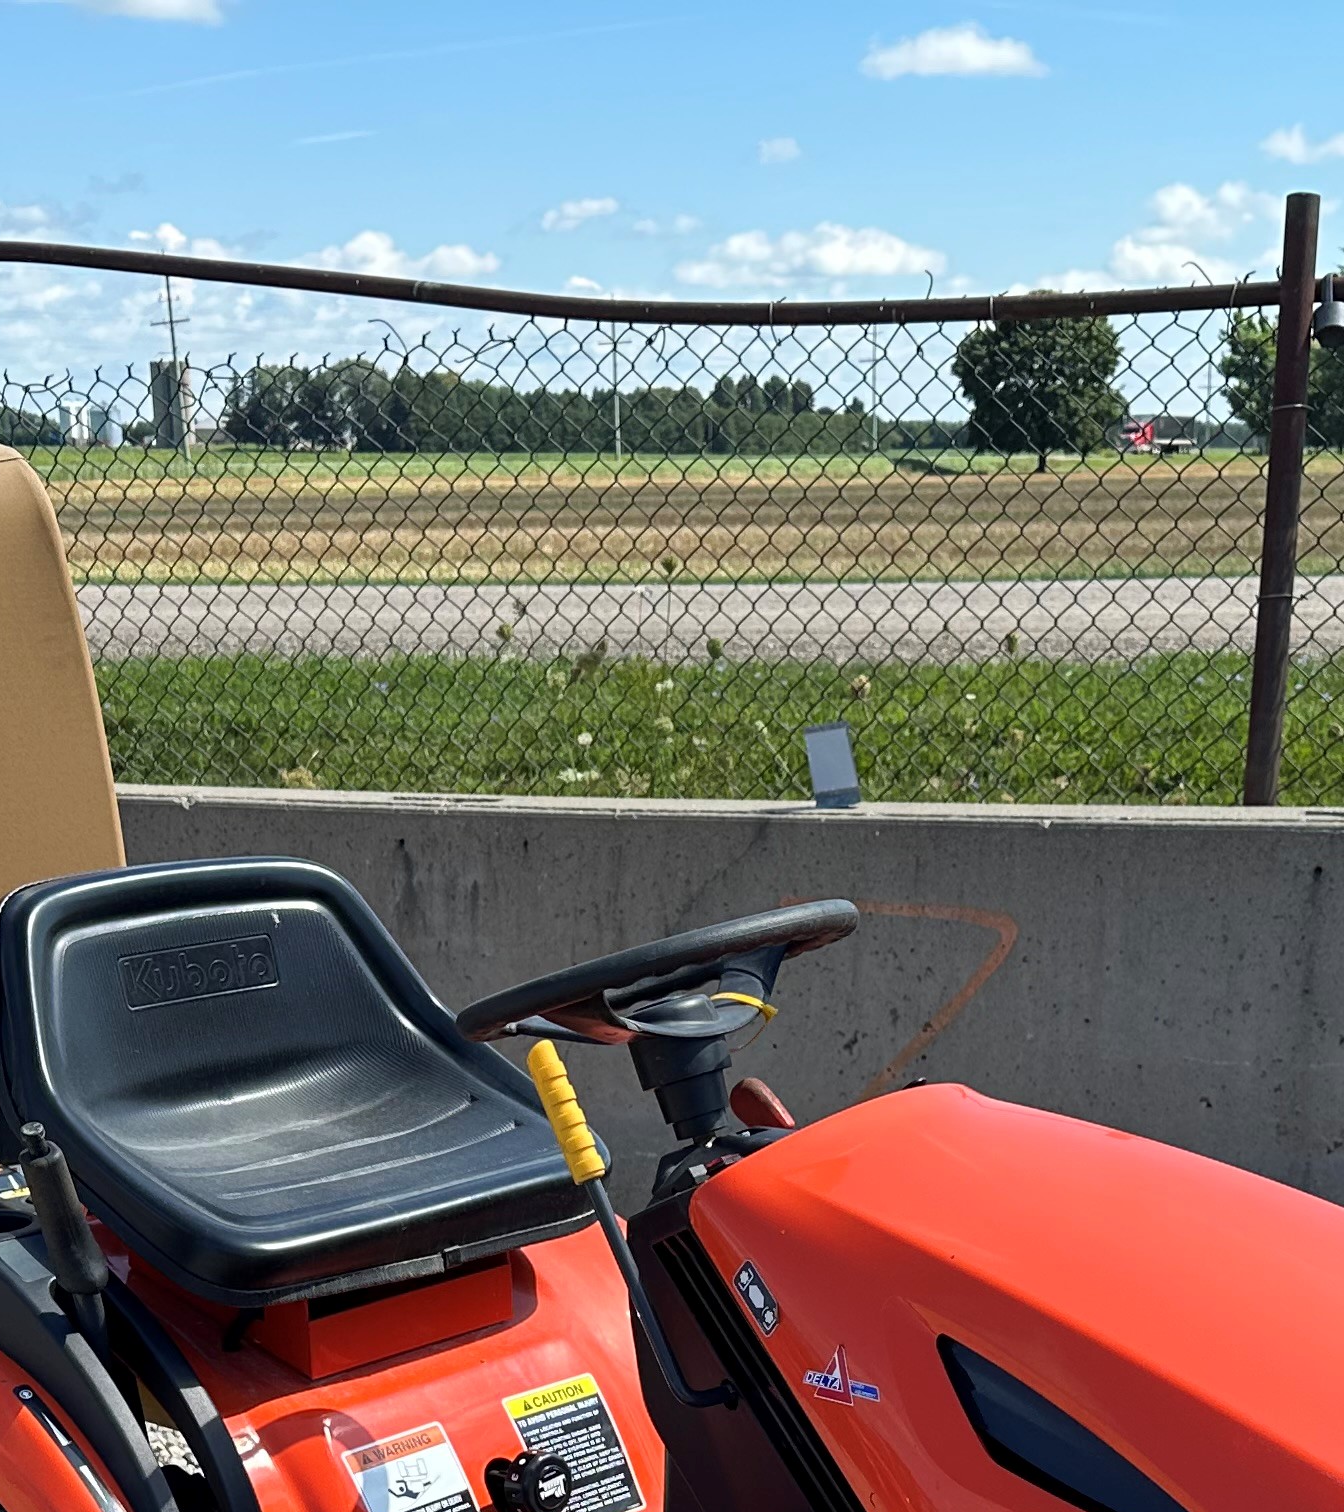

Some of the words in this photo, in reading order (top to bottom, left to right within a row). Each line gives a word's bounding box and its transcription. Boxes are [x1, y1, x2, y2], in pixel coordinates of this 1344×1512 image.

[124, 944, 271, 1001] Kubota
[805, 1372, 841, 1390] DELTA
[531, 1382, 584, 1408] CAUTION
[371, 1432, 432, 1461] WARNING
